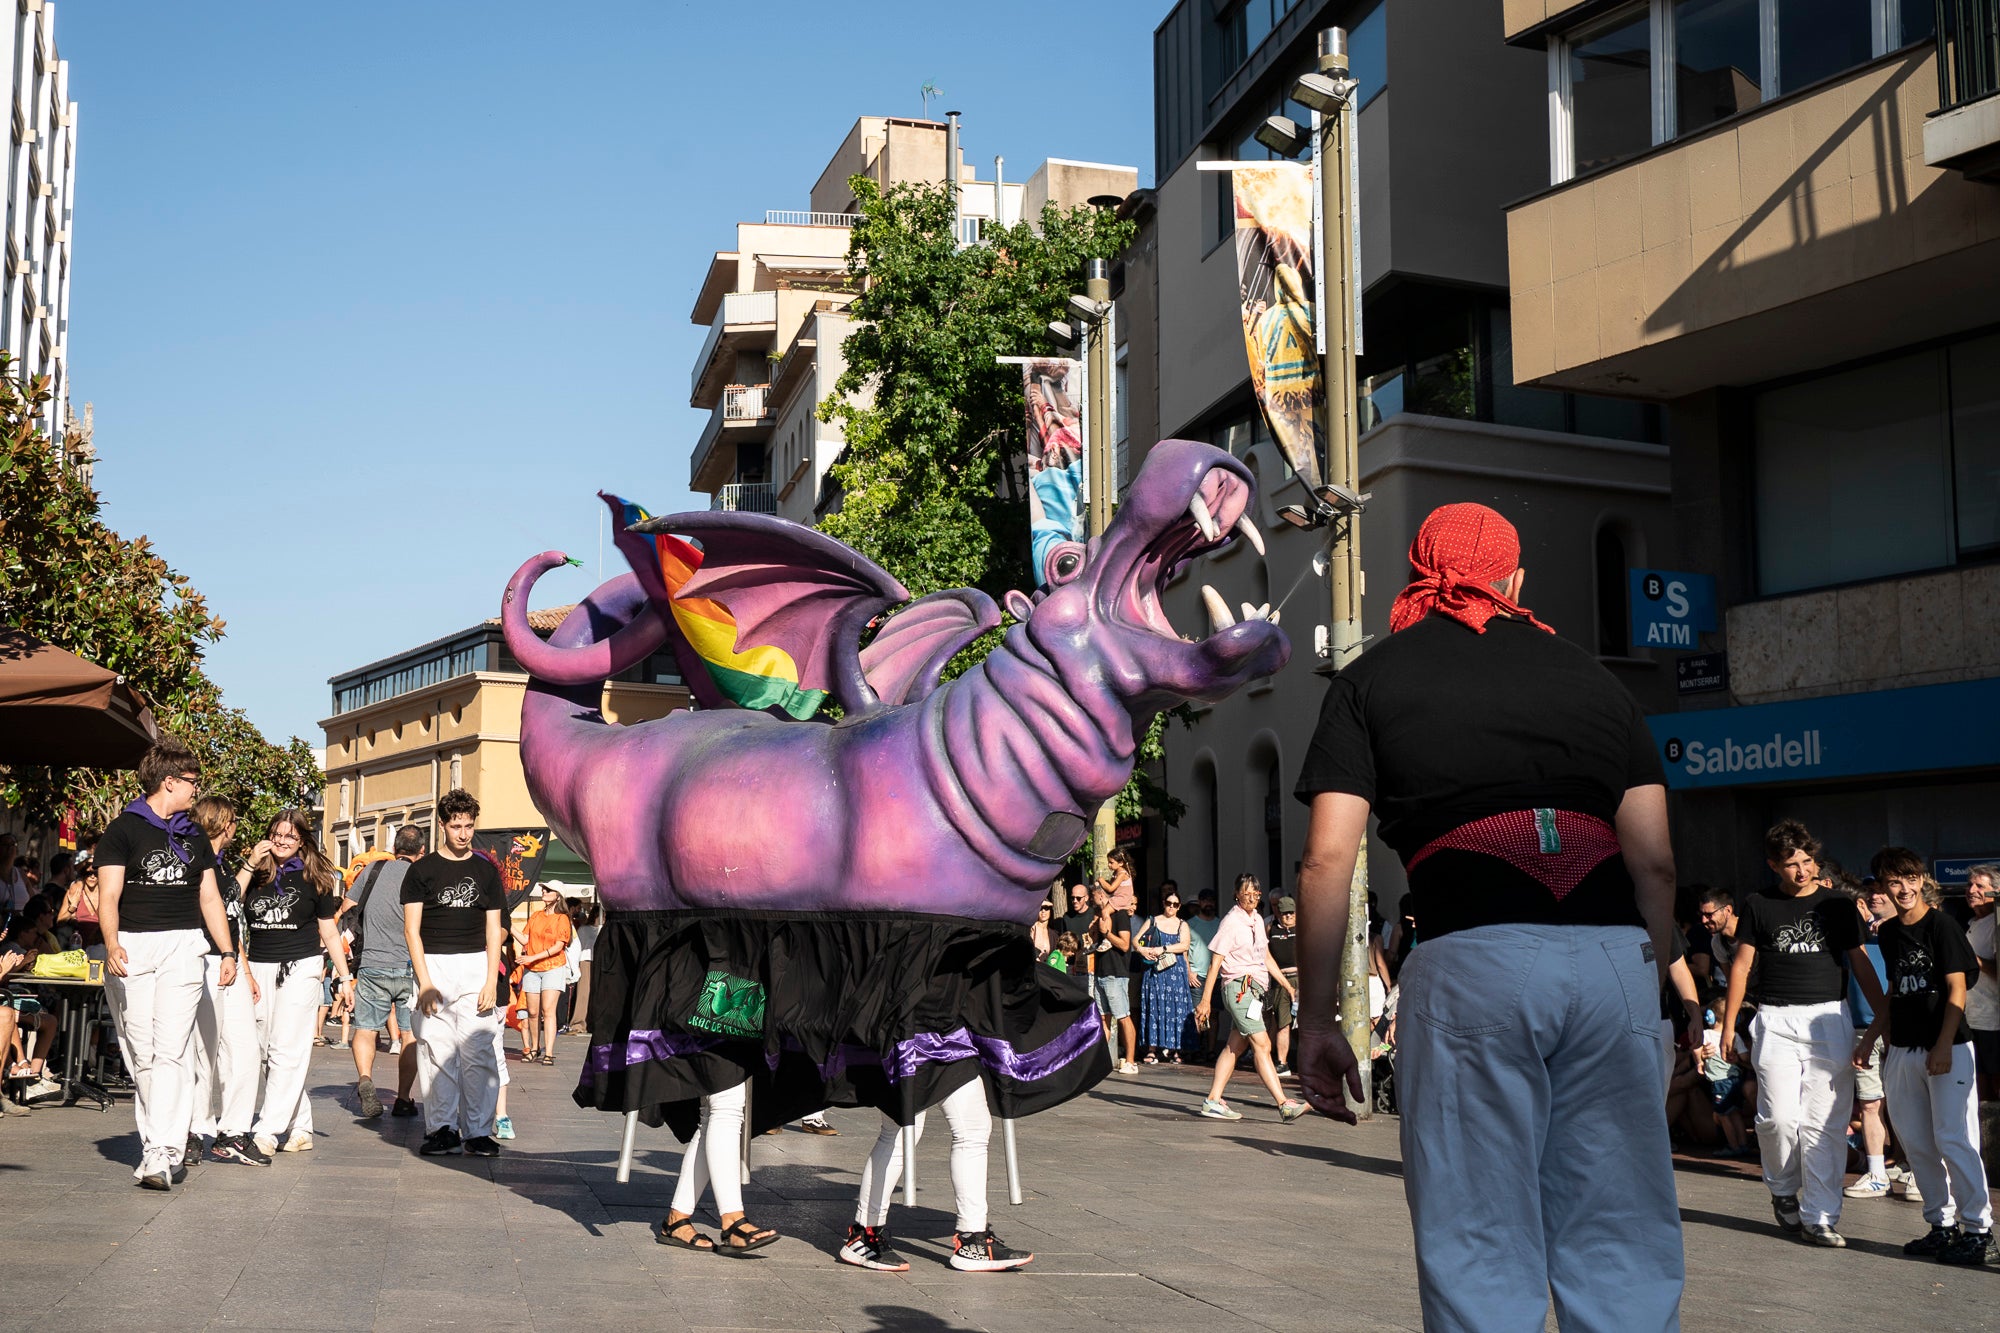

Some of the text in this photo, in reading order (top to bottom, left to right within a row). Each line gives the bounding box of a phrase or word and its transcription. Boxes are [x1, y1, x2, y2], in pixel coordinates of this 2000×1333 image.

[1666, 581, 1690, 618] S
[1647, 622, 1690, 645] ATM
[1679, 675, 1720, 688] MONTSERRAT
[1685, 730, 1821, 775] Sabadell
[958, 1247, 990, 1261] adidas
